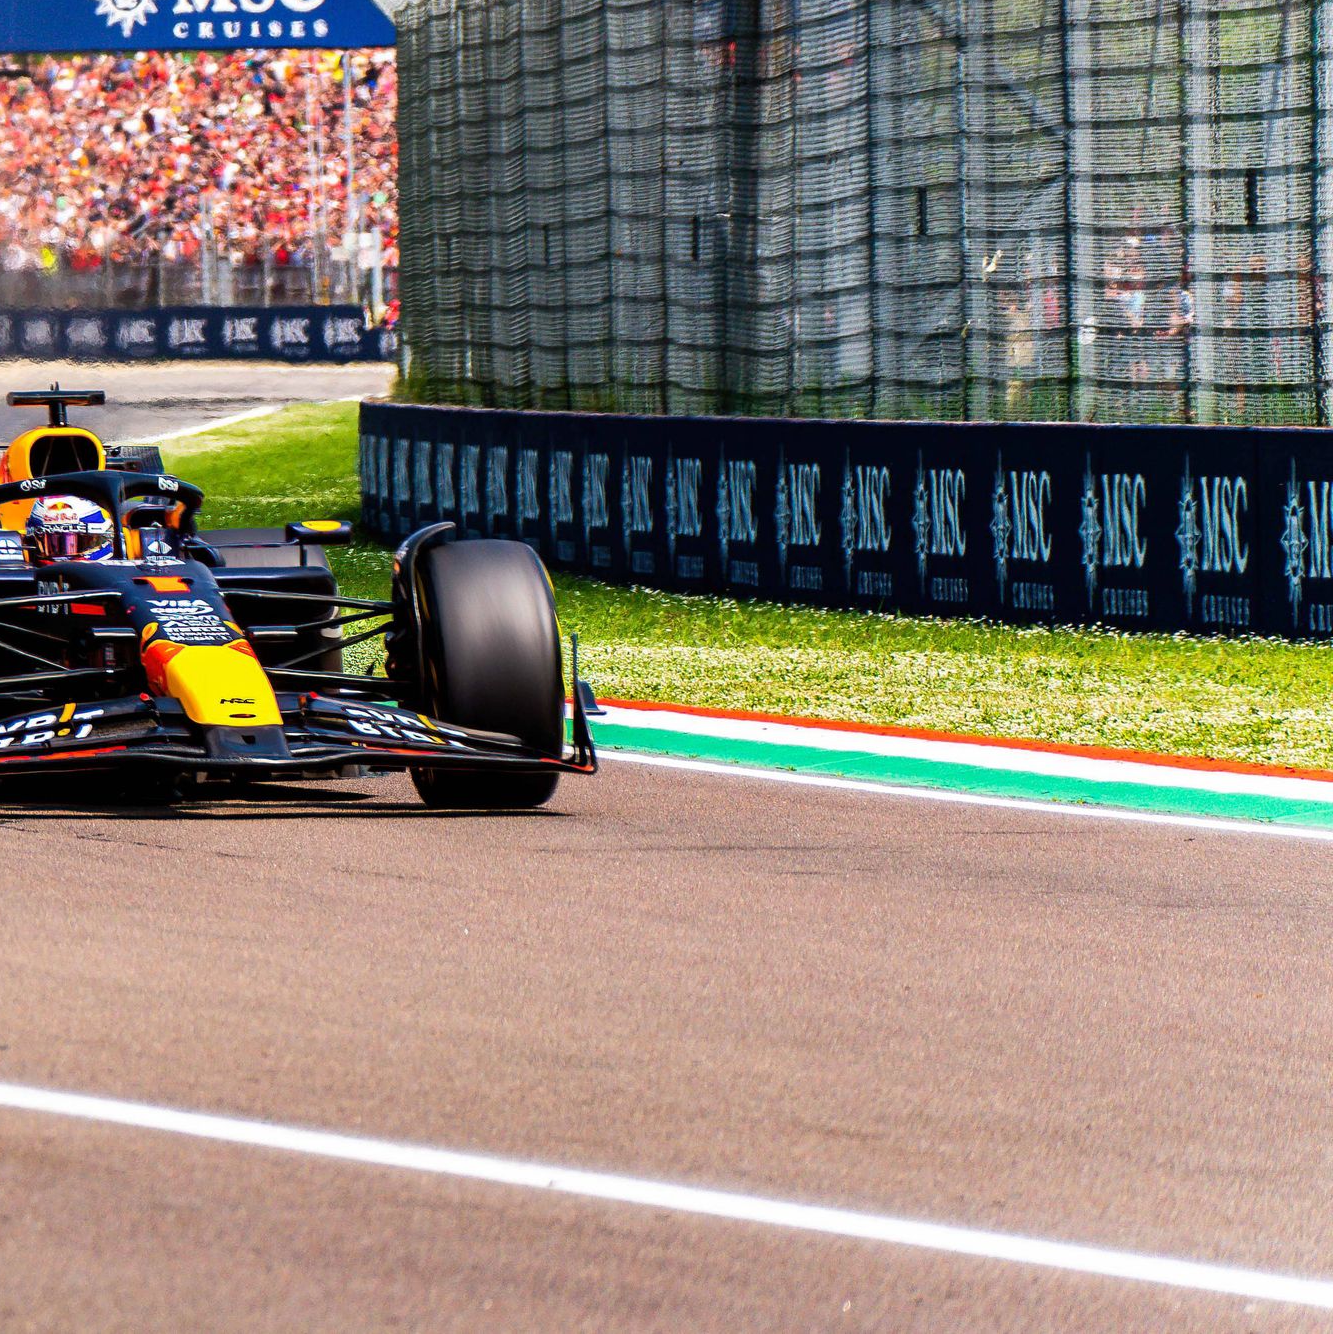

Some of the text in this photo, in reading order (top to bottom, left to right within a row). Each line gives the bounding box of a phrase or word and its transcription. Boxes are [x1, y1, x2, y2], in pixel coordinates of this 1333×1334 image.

[173, 19, 329, 39] CRUISES
[930, 469, 966, 556] MSC
[1011, 471, 1053, 562] MSC
[1102, 473, 1148, 568] MSC
[1200, 476, 1249, 574] MSC
[146, 599, 210, 607] VISA
